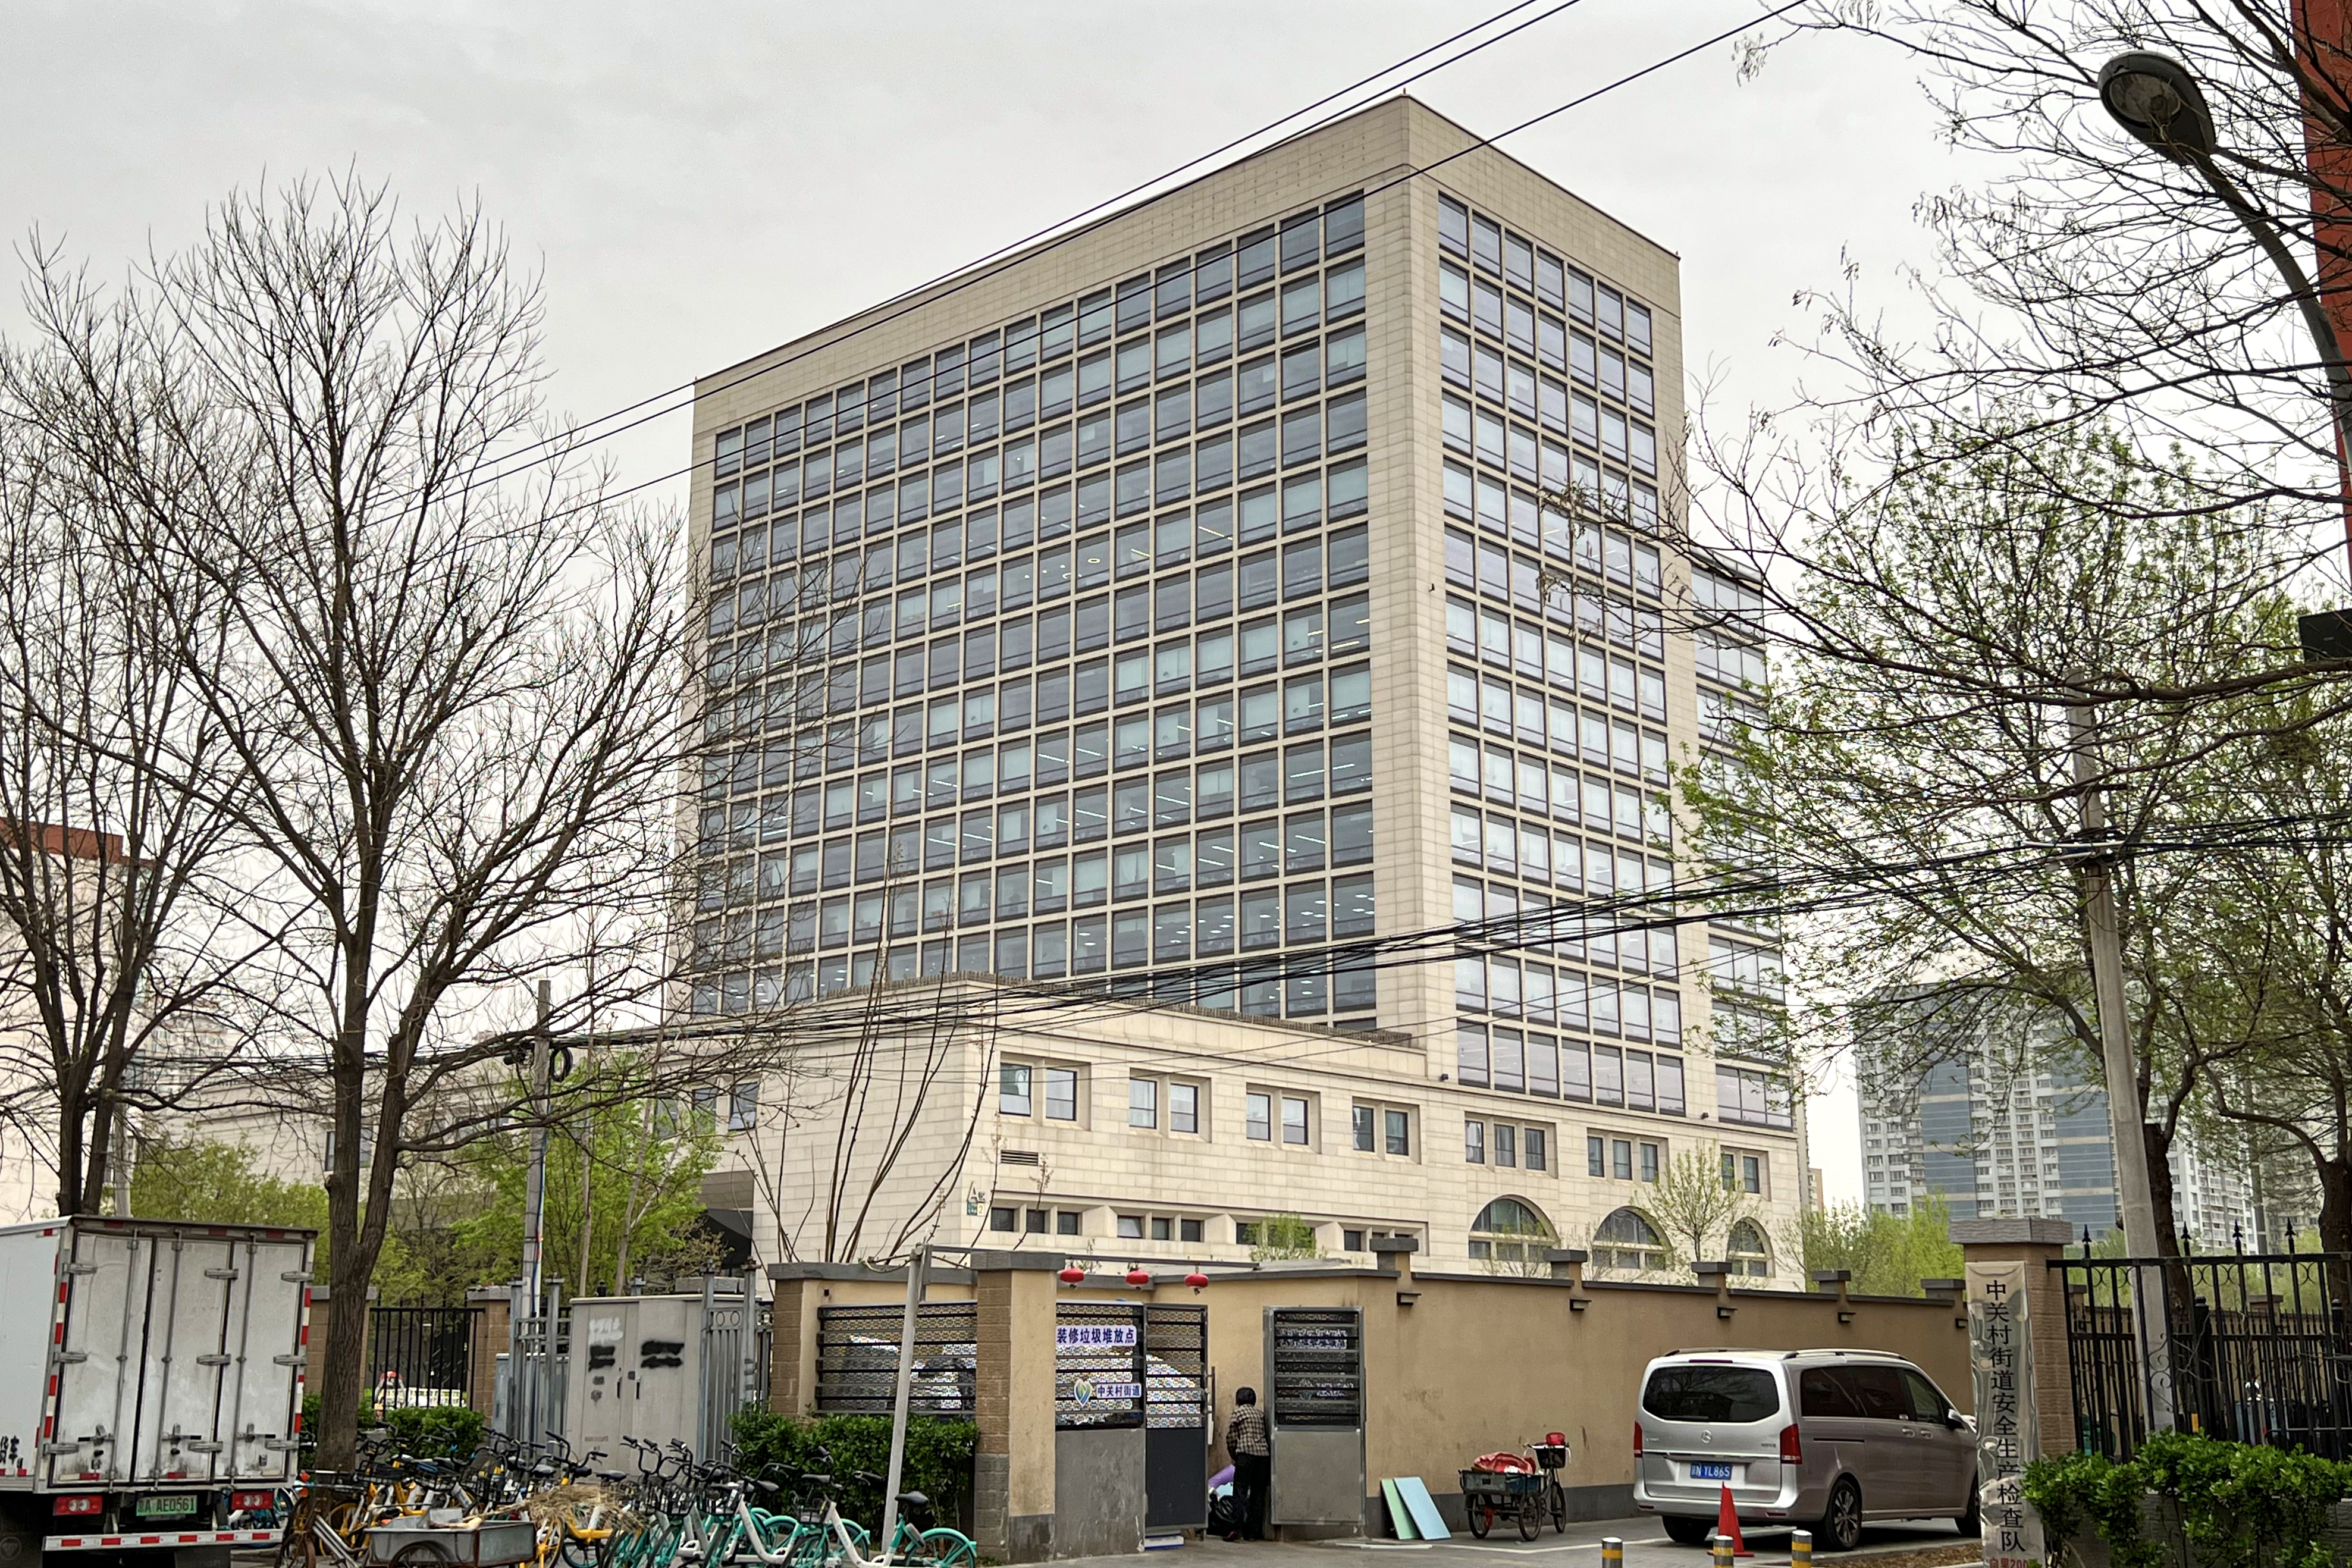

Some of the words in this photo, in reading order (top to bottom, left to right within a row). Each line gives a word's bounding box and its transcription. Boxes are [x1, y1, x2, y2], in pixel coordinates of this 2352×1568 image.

[1056, 1327, 1135, 1344] 装修垃圾堆放点
[1097, 1384, 1140, 1397] 中关村街道
[1986, 1280, 2026, 1552] 中关村街道安全生产检查队
